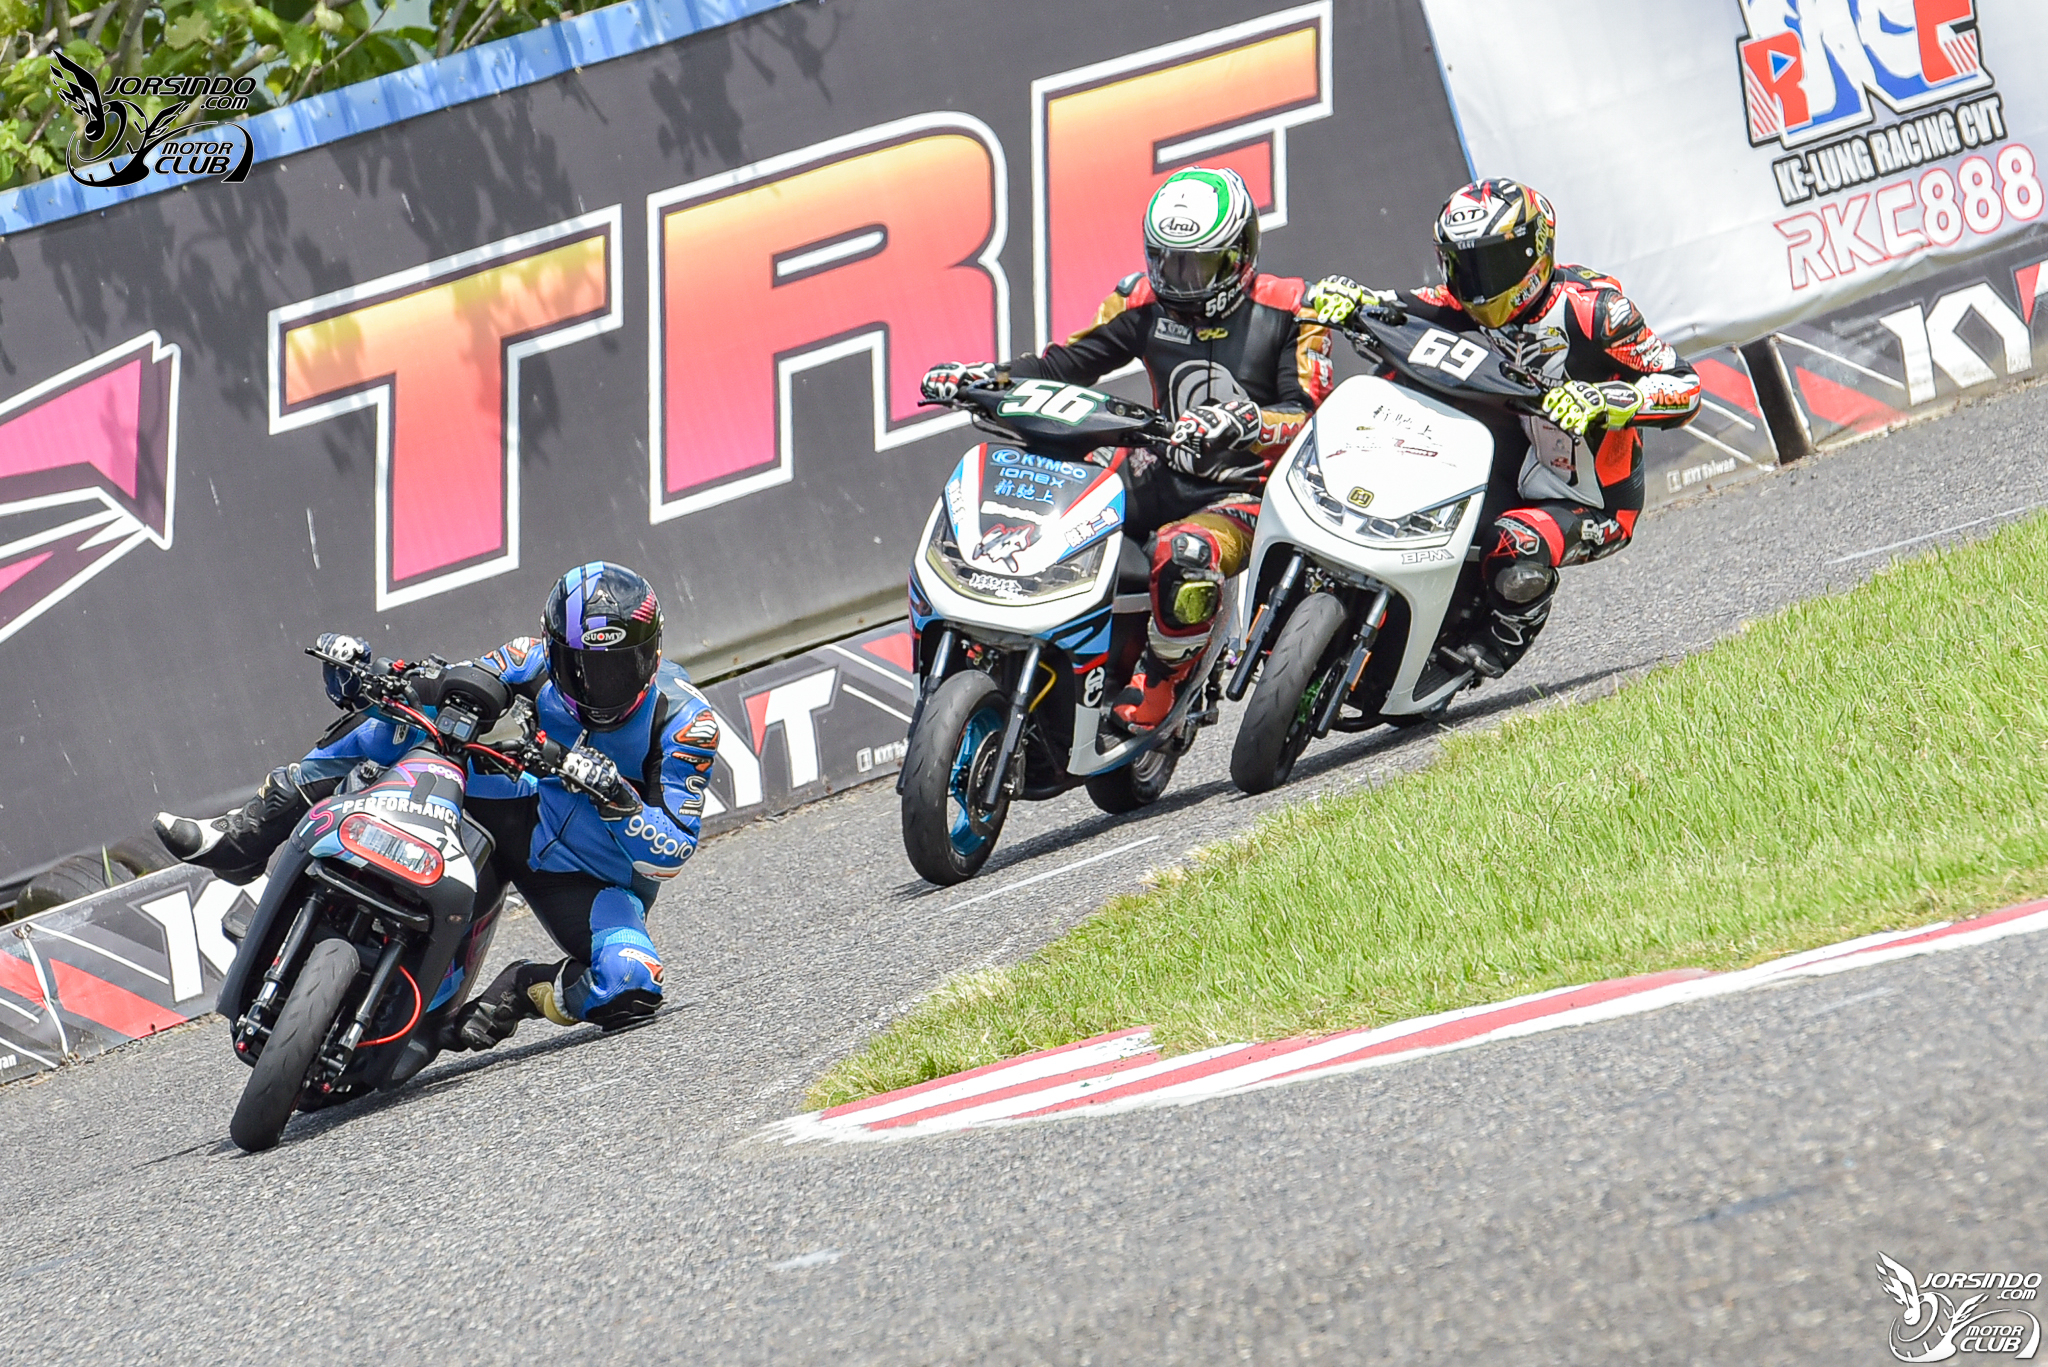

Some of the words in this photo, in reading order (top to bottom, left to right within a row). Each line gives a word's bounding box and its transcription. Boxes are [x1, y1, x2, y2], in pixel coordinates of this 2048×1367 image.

[1774, 139, 1875, 204] KE-LUNG
[1869, 110, 1960, 174] RACING
[1957, 96, 2006, 149] CVT
[1163, 217, 1196, 234] Arai
[1204, 291, 1227, 318] 56
[1408, 327, 1489, 381] 69
[998, 378, 1106, 424] 56
[1021, 453, 1088, 479] KYMCO
[584, 631, 623, 643] SUOMY
[341, 796, 460, 830] PERFORMANCE
[436, 837, 465, 863] 17
